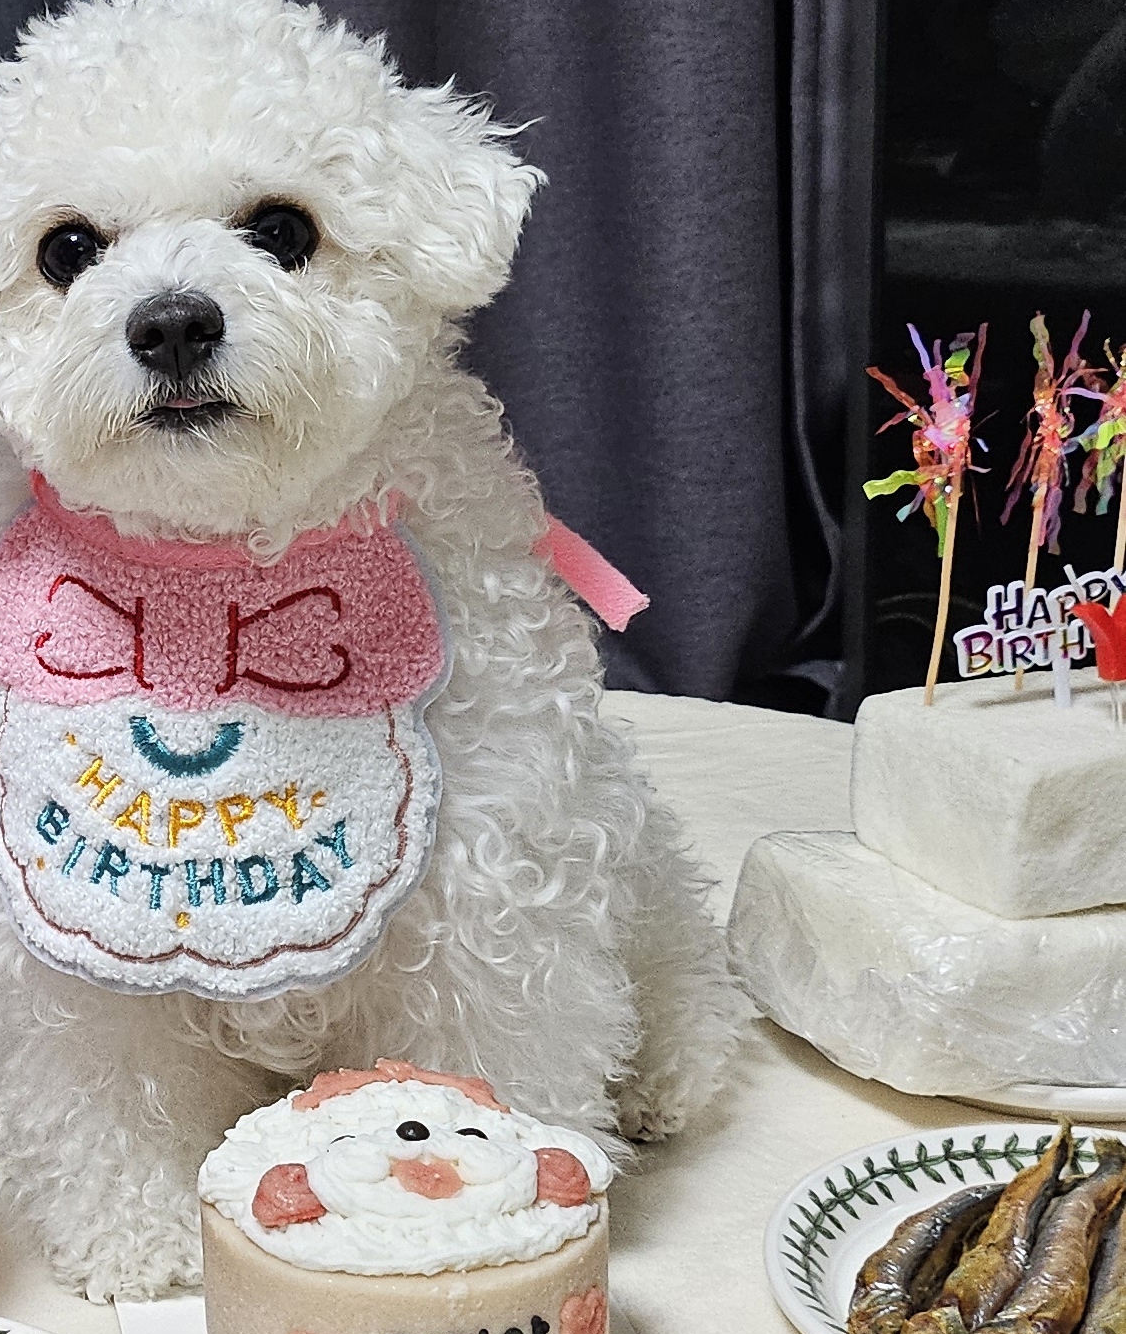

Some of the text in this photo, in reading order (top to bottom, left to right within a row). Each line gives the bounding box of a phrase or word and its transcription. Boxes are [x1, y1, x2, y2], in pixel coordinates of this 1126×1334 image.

[991, 574, 1126, 631] HAPP
[961, 628, 1096, 674] BIRTH
[76, 754, 305, 848] HAPPY
[35, 799, 356, 910] BIRTHDAY
